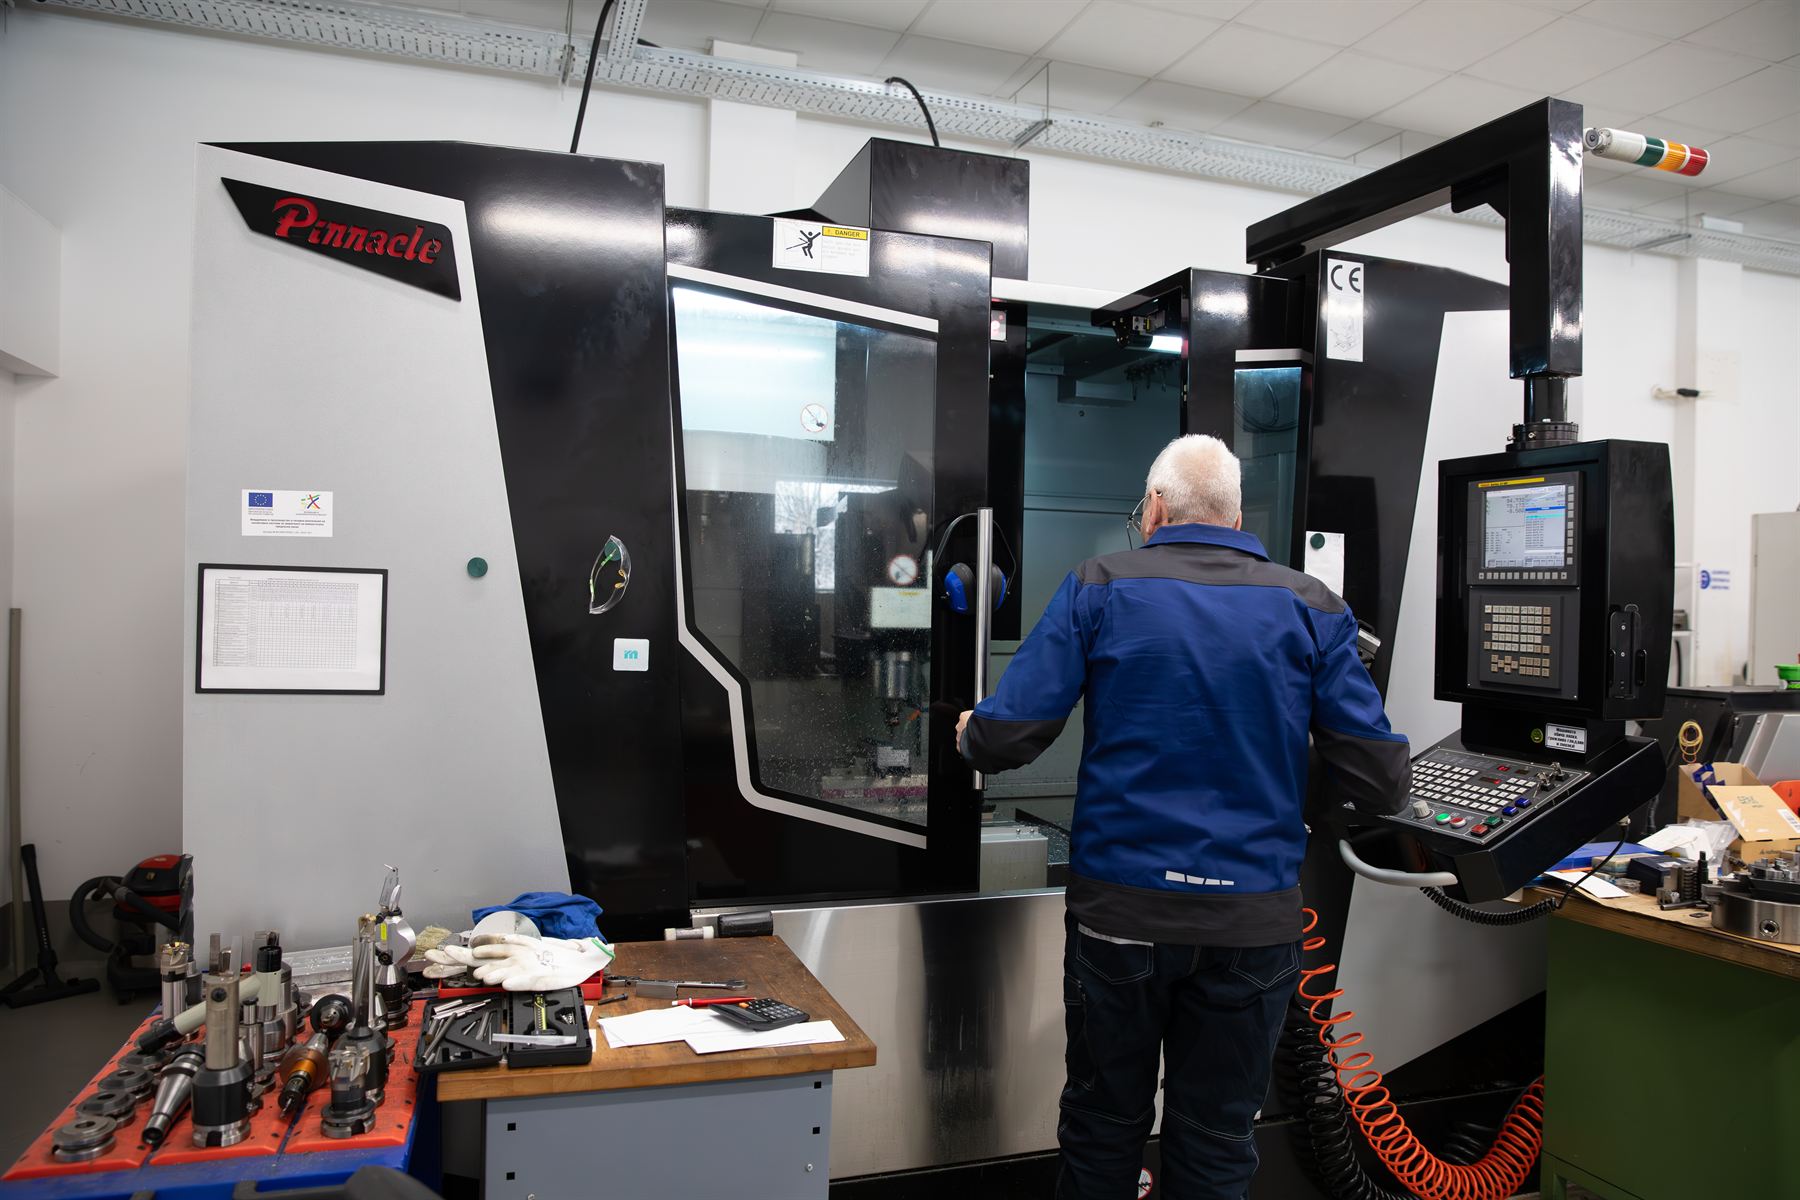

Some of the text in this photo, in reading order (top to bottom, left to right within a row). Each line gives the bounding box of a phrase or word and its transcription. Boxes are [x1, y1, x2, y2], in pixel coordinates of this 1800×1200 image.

[272, 197, 442, 264] Pinnacle
[835, 229, 861, 238] DANGER
[1330, 265, 1361, 293] CE
